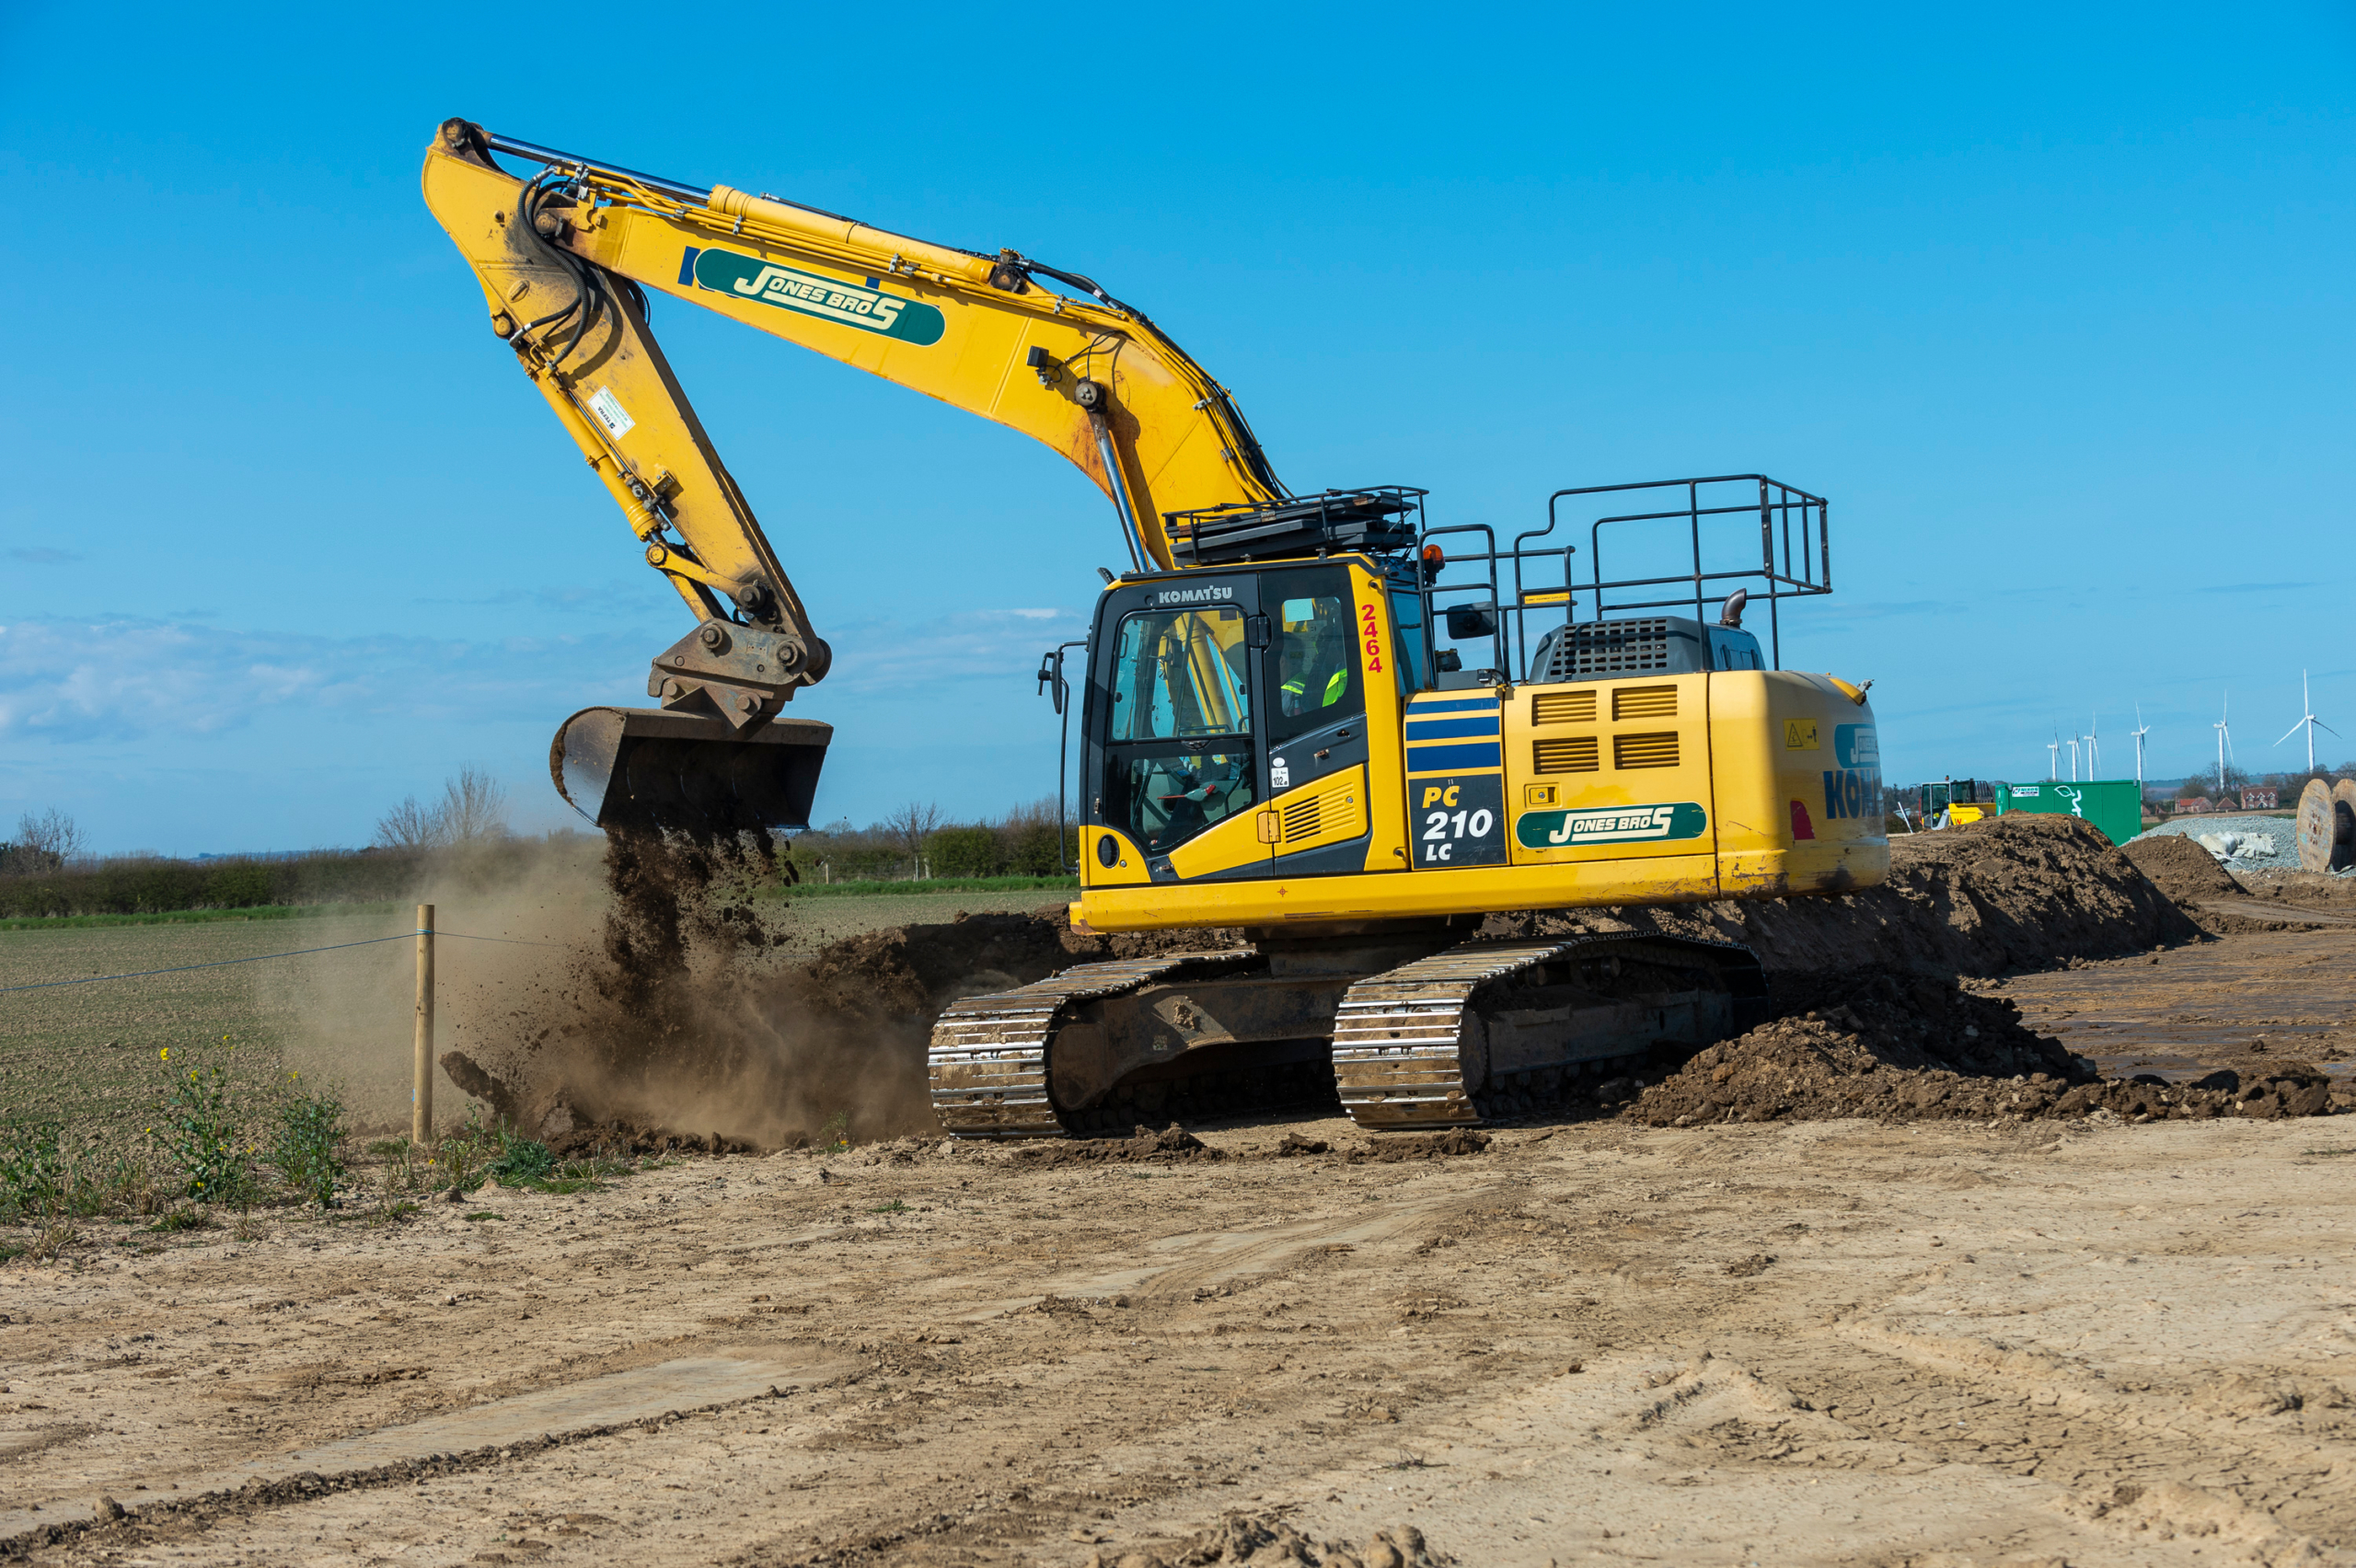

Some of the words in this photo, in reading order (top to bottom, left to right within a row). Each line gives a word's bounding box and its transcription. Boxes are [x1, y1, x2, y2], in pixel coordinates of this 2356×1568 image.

[733, 265, 827, 302] JONES
[826, 293, 907, 330] BROS
[1159, 585, 1232, 604] KOMATSU
[1361, 604, 1382, 673] 2464
[1273, 776, 1284, 786] 102
[1422, 785, 1460, 809] PC
[1422, 808, 1493, 840] 210
[1549, 813, 1617, 844] JONES
[1617, 806, 1674, 836] BROS
[1426, 843, 1452, 861] LC
